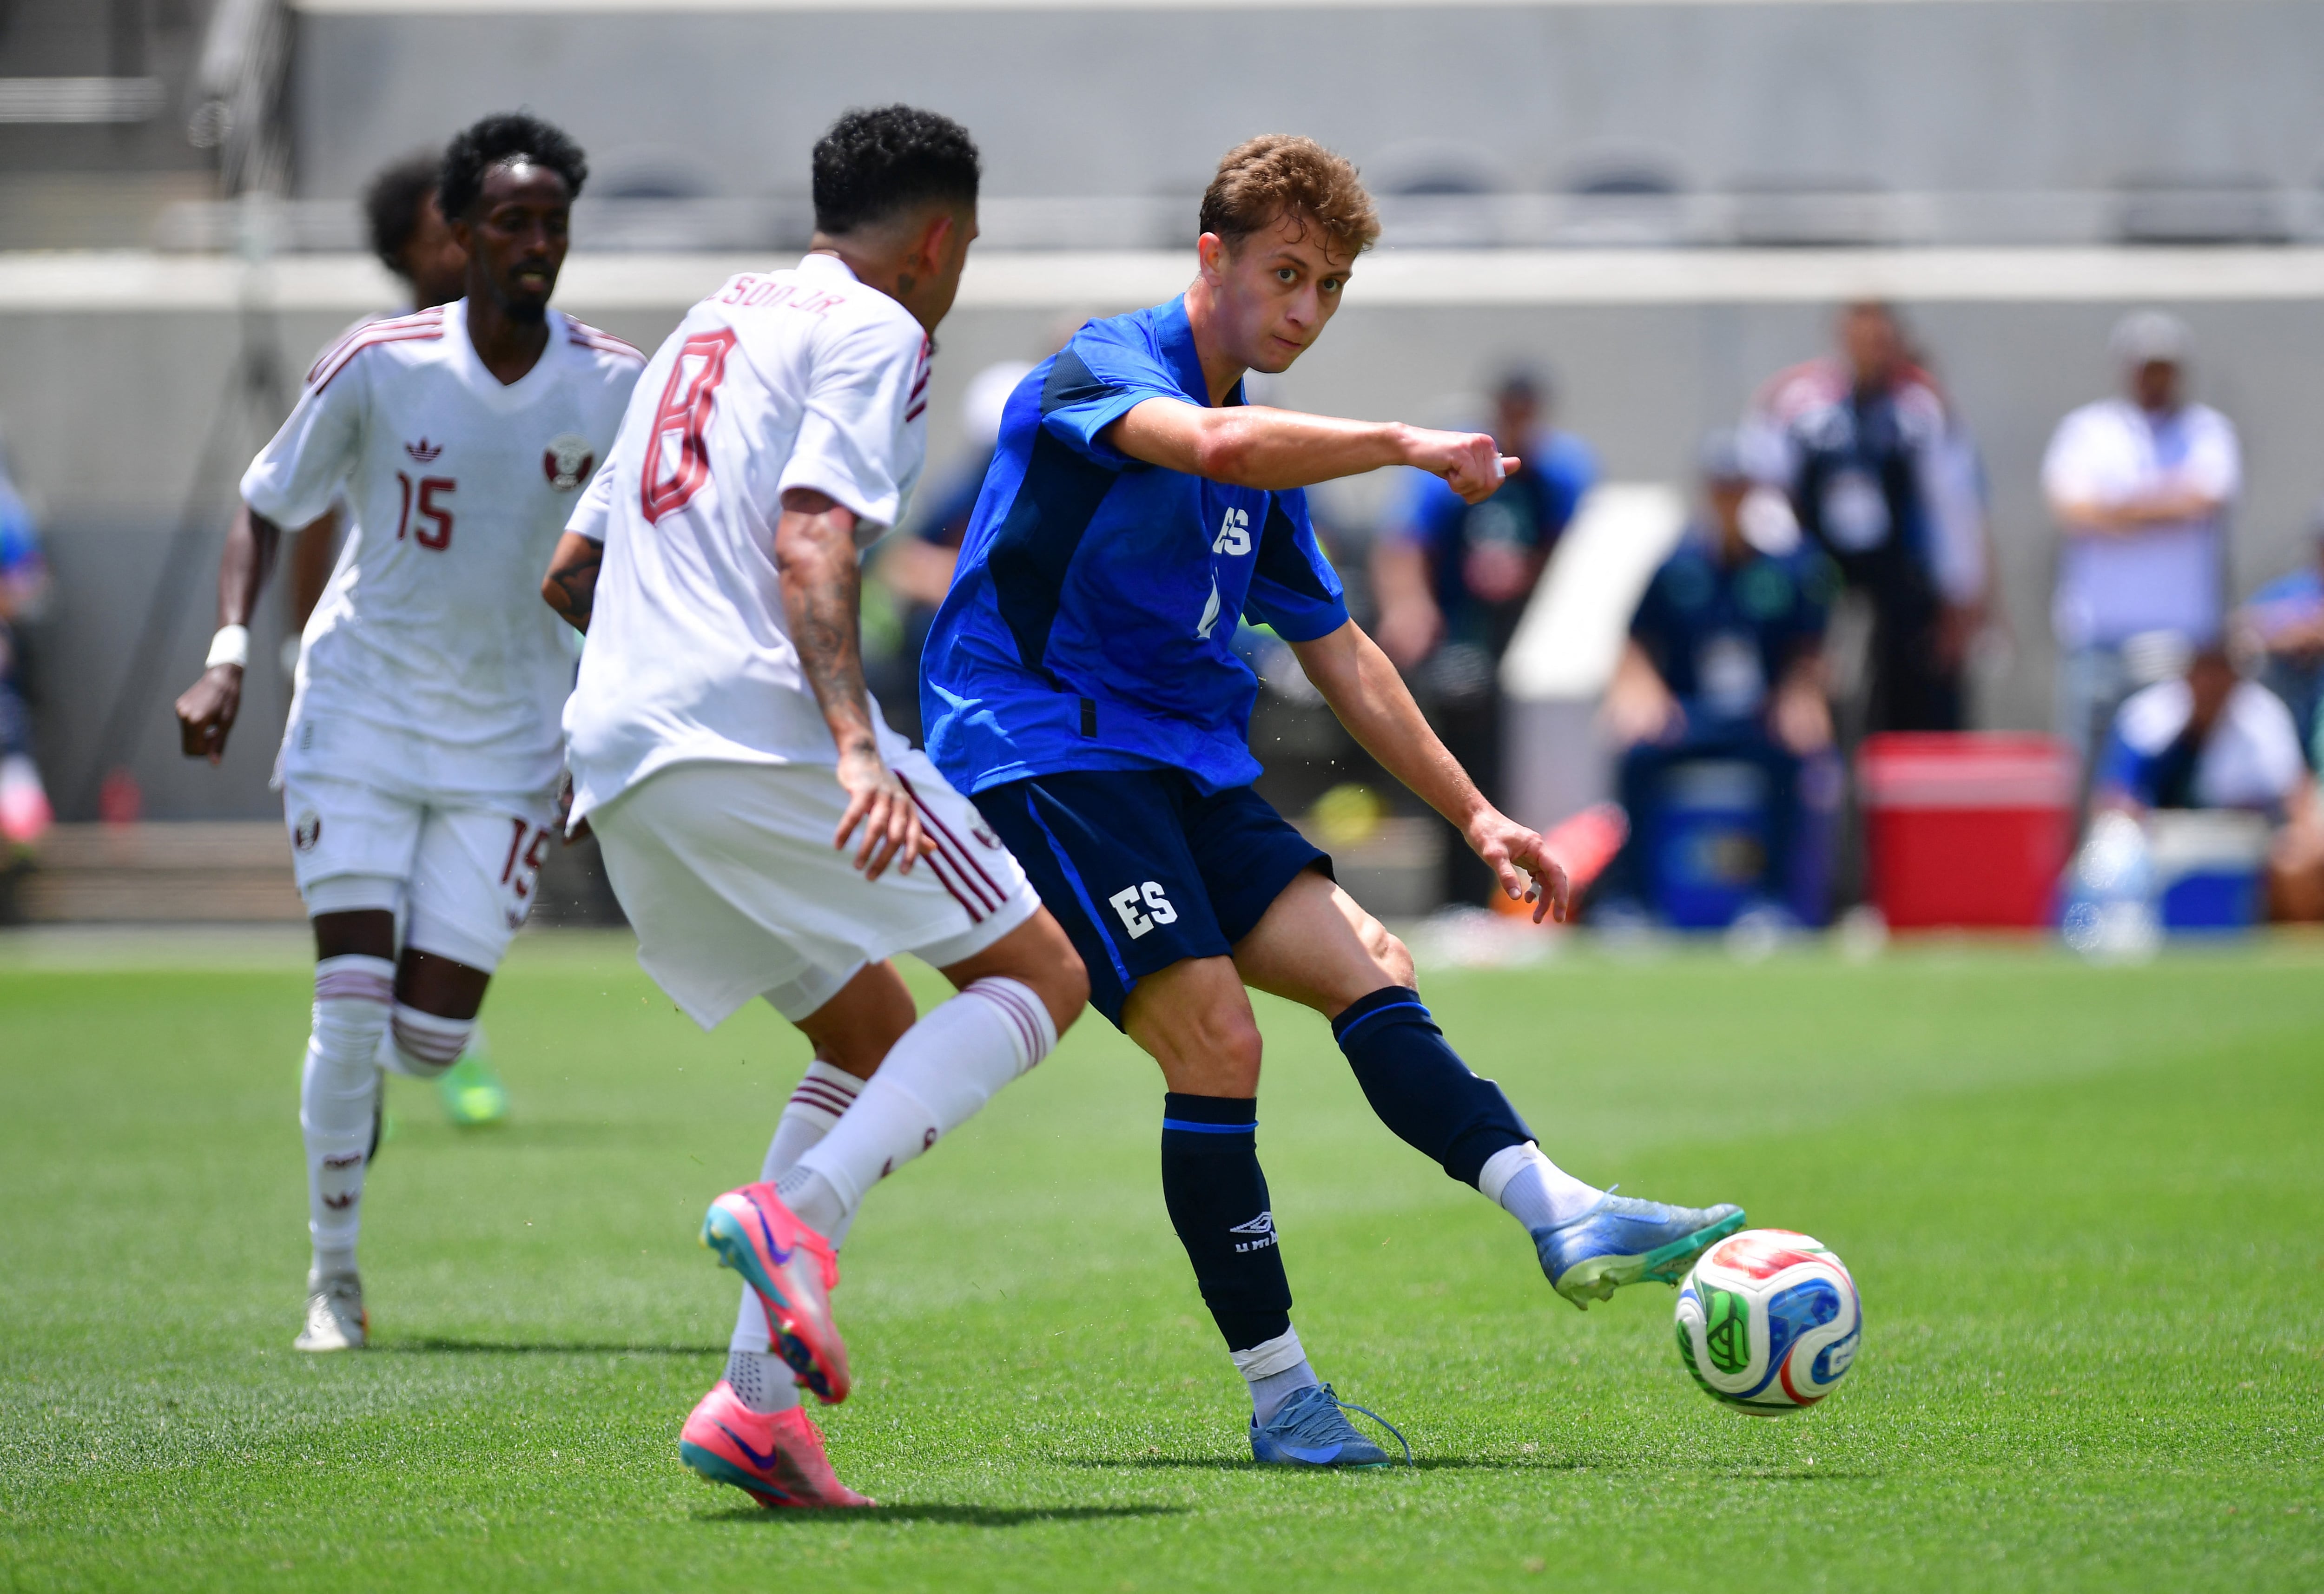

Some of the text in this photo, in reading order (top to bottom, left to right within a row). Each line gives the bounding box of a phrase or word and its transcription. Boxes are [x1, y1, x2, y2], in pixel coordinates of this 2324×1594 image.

[641, 326, 738, 528] 8
[396, 471, 456, 551] 15
[1109, 881, 1178, 940] ES
